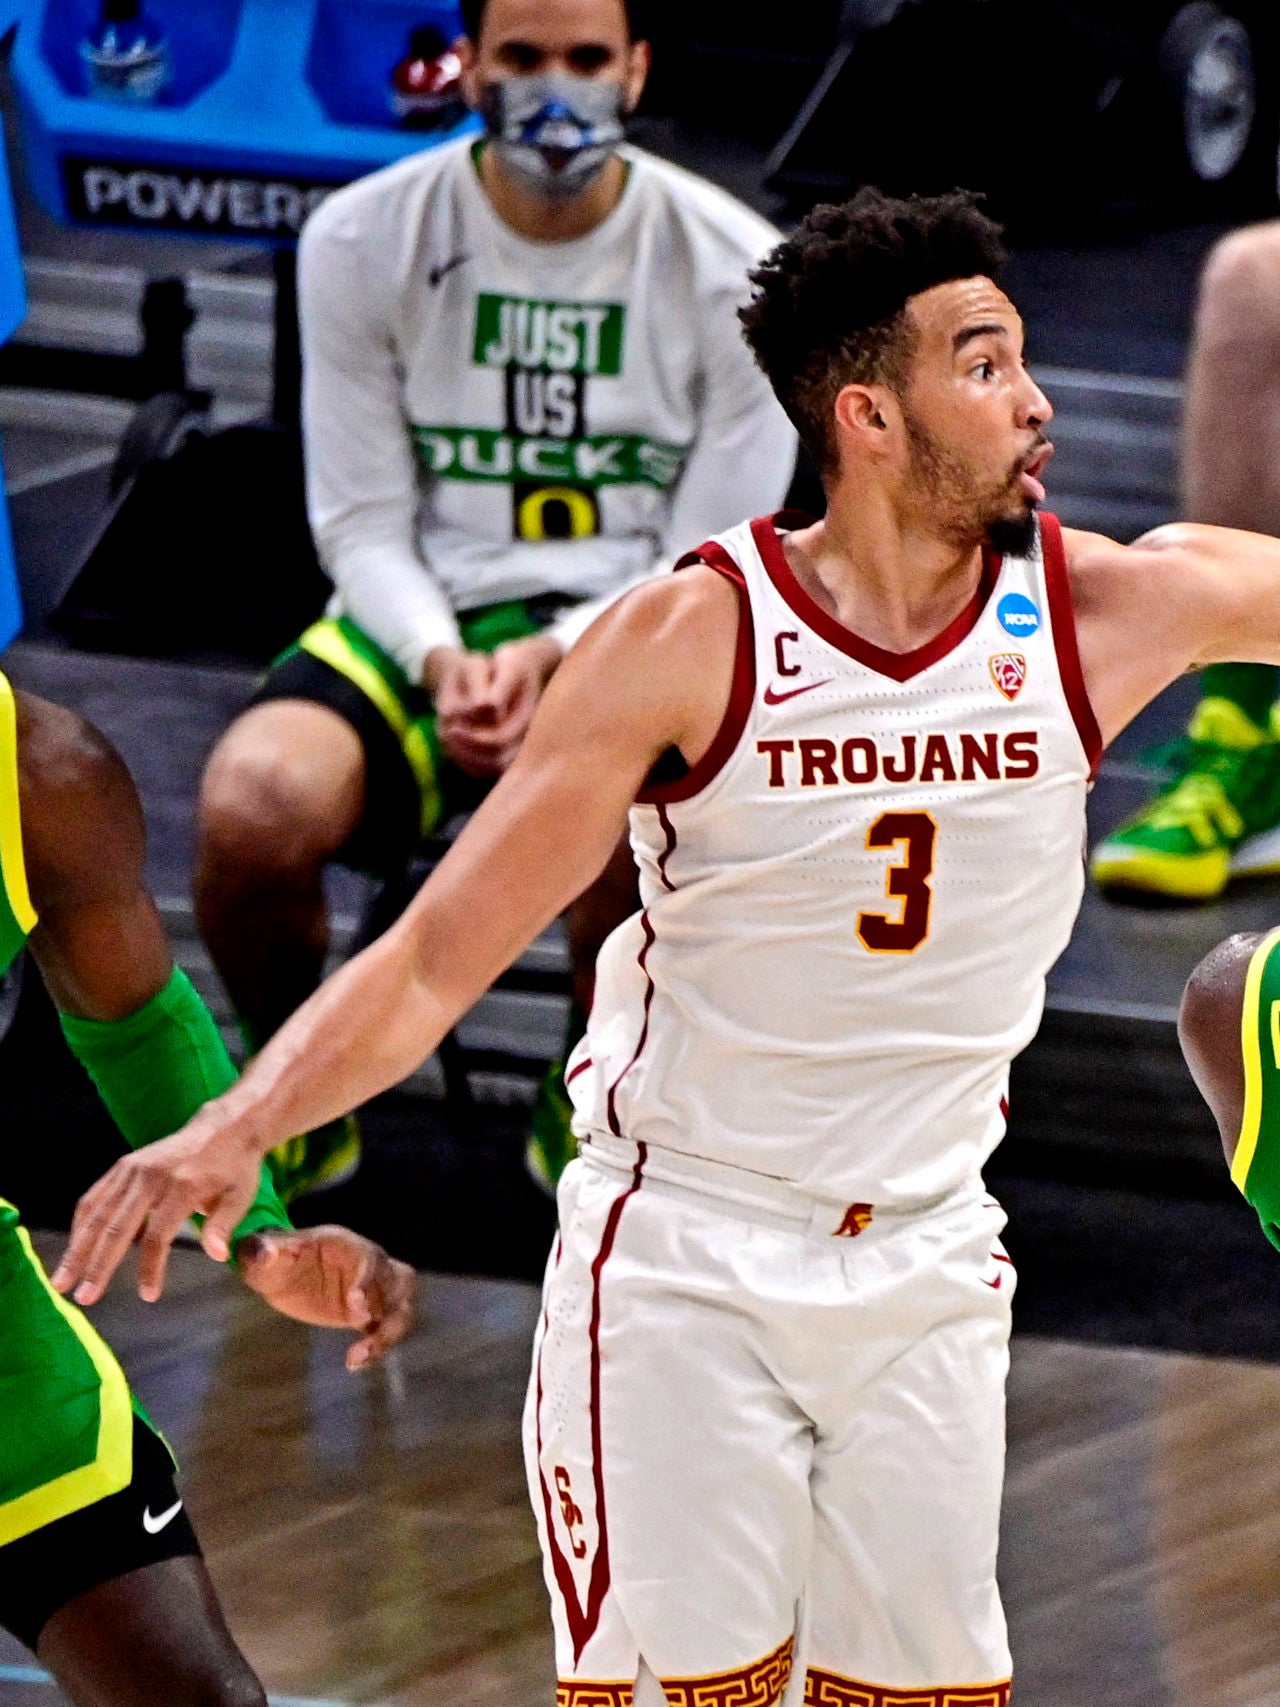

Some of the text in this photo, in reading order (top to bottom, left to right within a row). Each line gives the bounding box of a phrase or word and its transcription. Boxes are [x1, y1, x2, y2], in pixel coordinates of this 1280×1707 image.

[484, 300, 607, 373] JUST
[514, 369, 577, 438] US
[517, 485, 596, 541] O
[1004, 612, 1039, 626] NCAA
[774, 631, 801, 676] C
[756, 731, 1039, 788] TROJANS
[856, 809, 938, 954] 3
